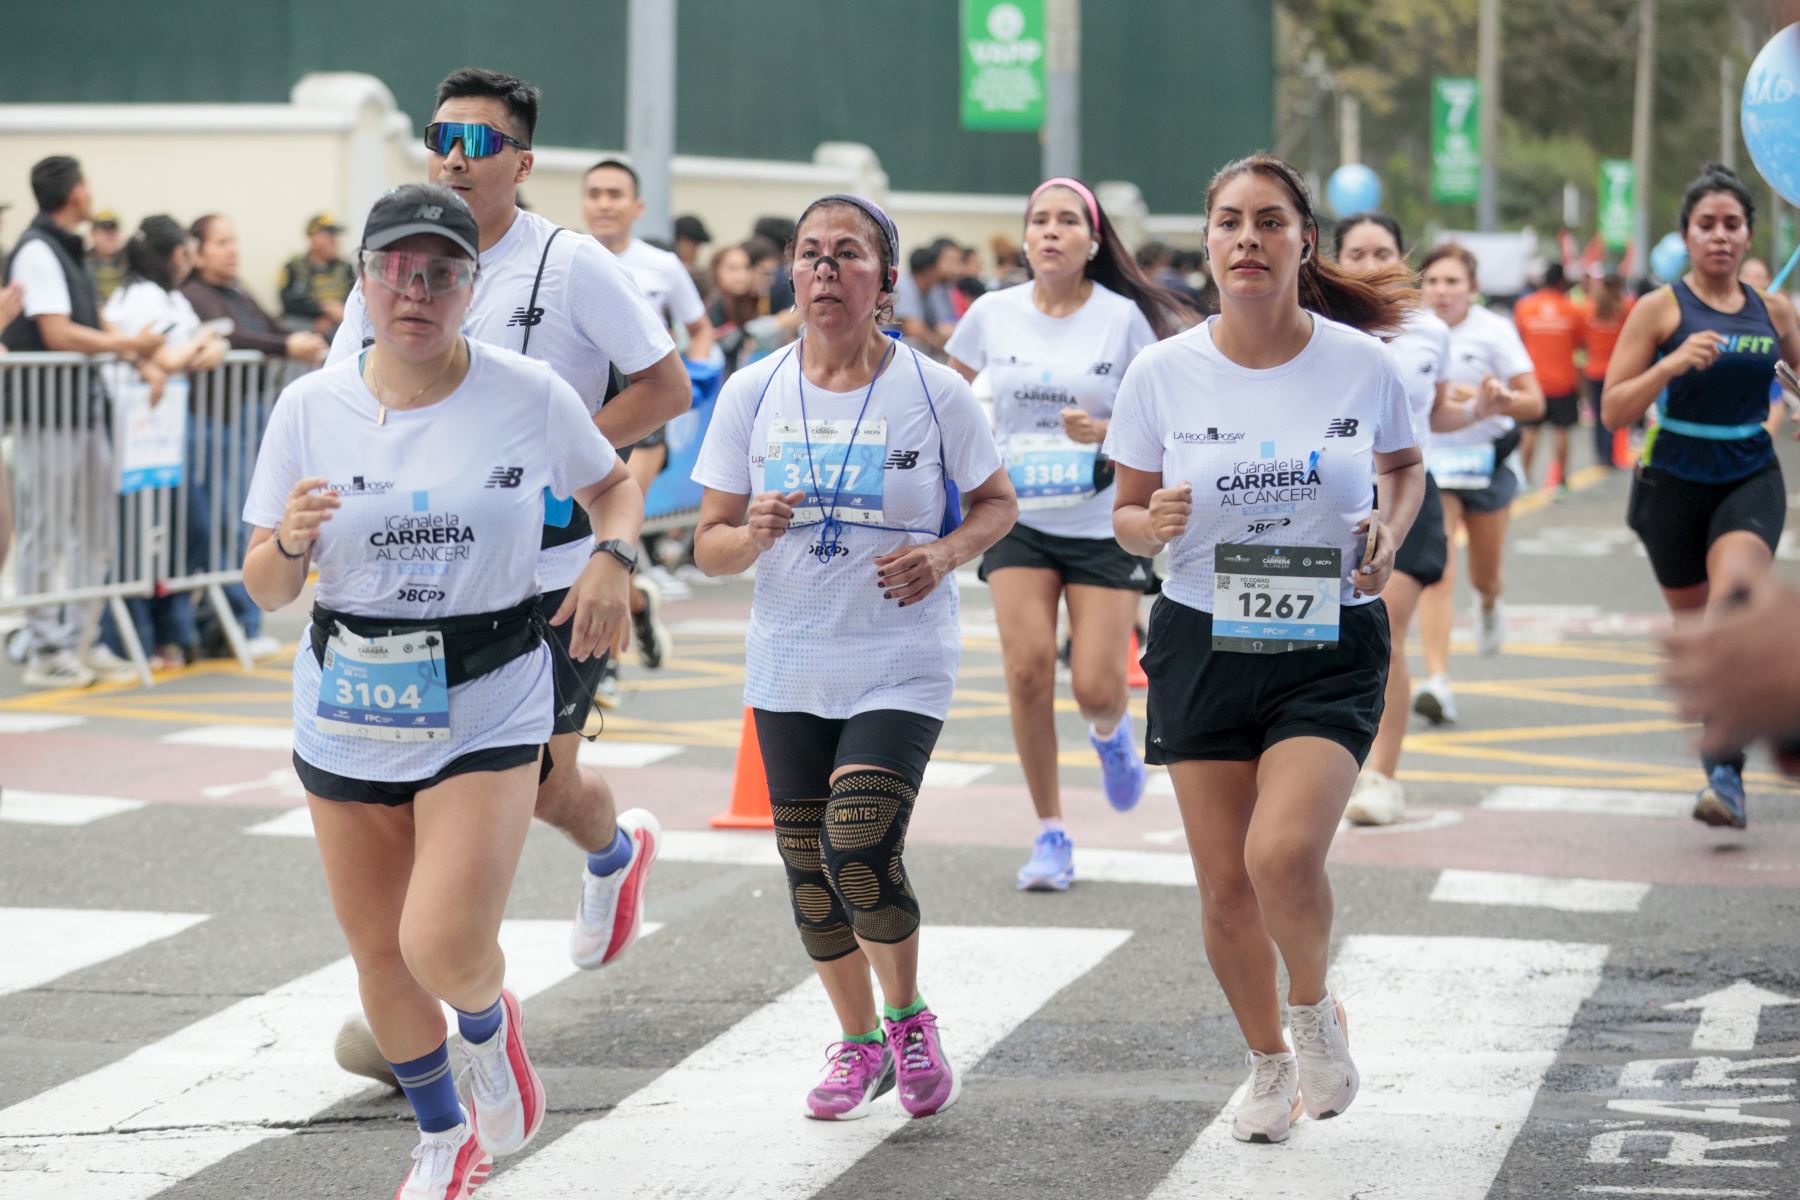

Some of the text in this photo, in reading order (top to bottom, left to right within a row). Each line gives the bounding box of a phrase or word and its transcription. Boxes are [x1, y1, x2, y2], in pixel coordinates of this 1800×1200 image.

[1324, 418, 1359, 438] NB
[883, 449, 920, 470] NB
[1290, 459, 1304, 470] la
[484, 466, 524, 489] NB
[783, 463, 861, 491] 3477
[1024, 464, 1080, 485] 3384
[1216, 469, 1322, 491] CARRERA
[1220, 485, 1317, 507] AL CÁNCER!
[445, 512, 459, 526] la
[369, 526, 475, 547] CARRERA
[375, 547, 397, 561] AL
[1239, 592, 1314, 619] 1267
[336, 678, 422, 710] 3104
